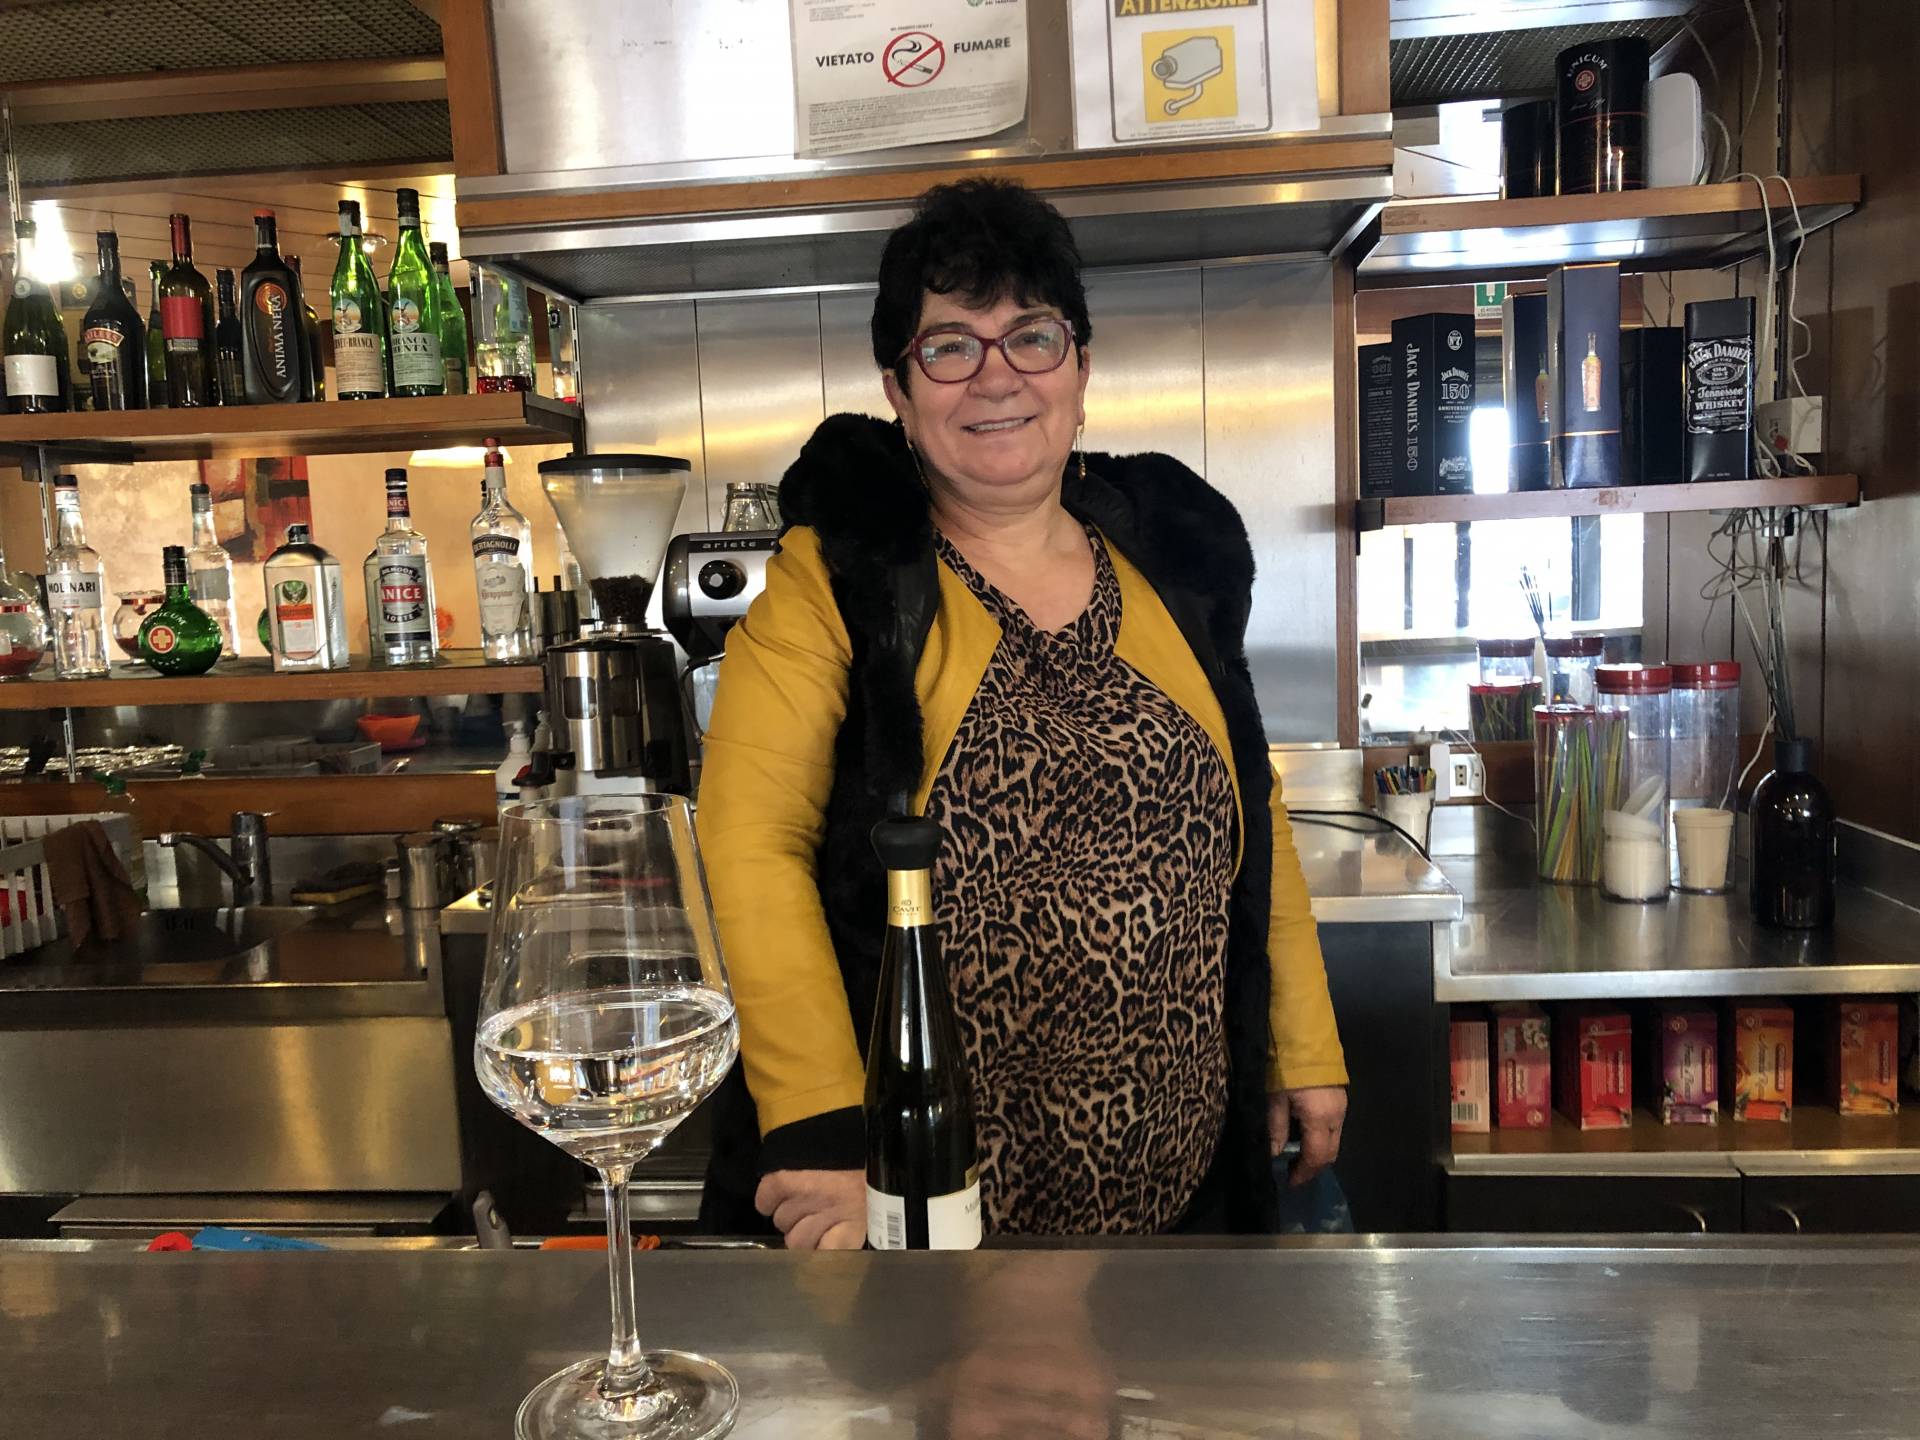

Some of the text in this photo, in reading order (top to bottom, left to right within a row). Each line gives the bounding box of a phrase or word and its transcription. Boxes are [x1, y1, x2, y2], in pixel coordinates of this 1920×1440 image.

[1119, 0, 1249, 15] ATTENZ
[953, 37, 1012, 54] FUMARE
[815, 52, 875, 68] VIETATO
[270, 294, 287, 378] ANIMA NERA
[1688, 346, 1713, 368] JACK
[1441, 383, 1470, 400] 150
[1406, 343, 1420, 471] JACK DANIEL'S 150
[1695, 399, 1746, 411] WHISKEY
[702, 540, 757, 549] ariete
[48, 582, 96, 593] MOLNARI
